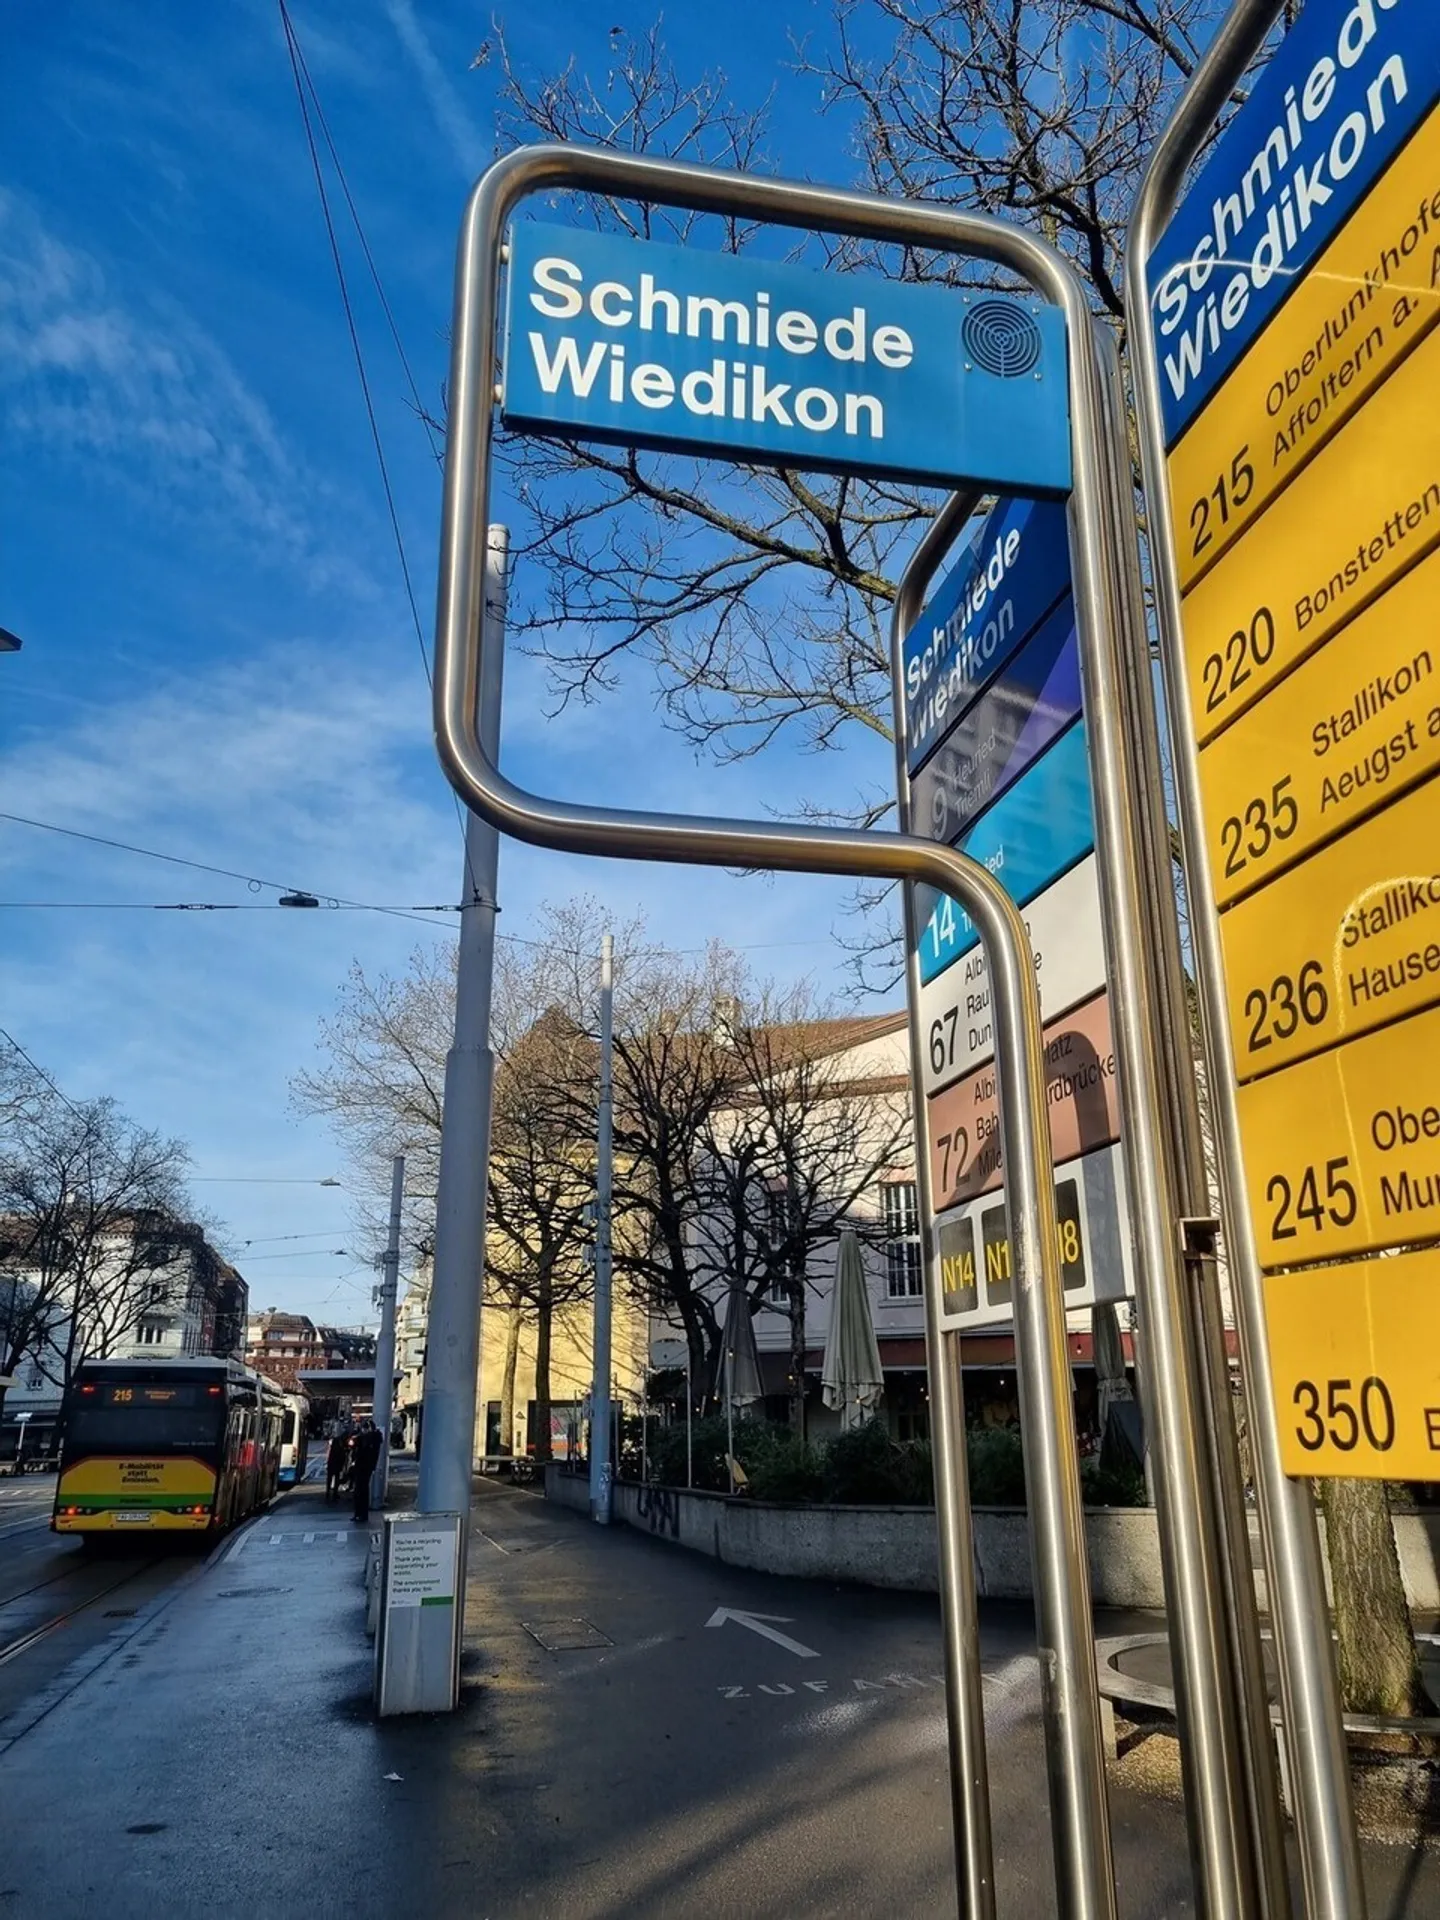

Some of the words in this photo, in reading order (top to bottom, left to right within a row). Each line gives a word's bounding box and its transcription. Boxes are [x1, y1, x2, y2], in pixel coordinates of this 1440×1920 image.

[1158, 0, 1399, 336] Schmied
[1164, 54, 1408, 401] Wiedikon
[529, 256, 914, 369] Schmiede
[528, 330, 884, 439] Wiedikon
[1273, 325, 1384, 467] Affoltern
[1392, 295, 1419, 329] a.
[1189, 444, 1255, 558] 215
[907, 528, 1020, 701] Schmiede
[1202, 606, 1275, 714] 220
[1295, 483, 1440, 631] Bonstetten
[908, 598, 1015, 748] Wiedikon
[1312, 650, 1433, 757] Stallikon
[931, 787, 948, 840] 9
[1220, 774, 1299, 879] 235
[1320, 720, 1419, 814] Aeugst
[927, 894, 956, 958] 14
[930, 1006, 959, 1075] 67
[1244, 960, 1329, 1053] 236
[1348, 943, 1440, 1006] Hause
[1048, 1054, 1115, 1105] rdbrücke
[937, 1126, 970, 1193] 72
[1266, 1155, 1357, 1241] 245
[943, 1251, 975, 1294] N14
[986, 1240, 1011, 1282] N1
[113, 1389, 134, 1401] 215
[1292, 1375, 1396, 1452] 350
